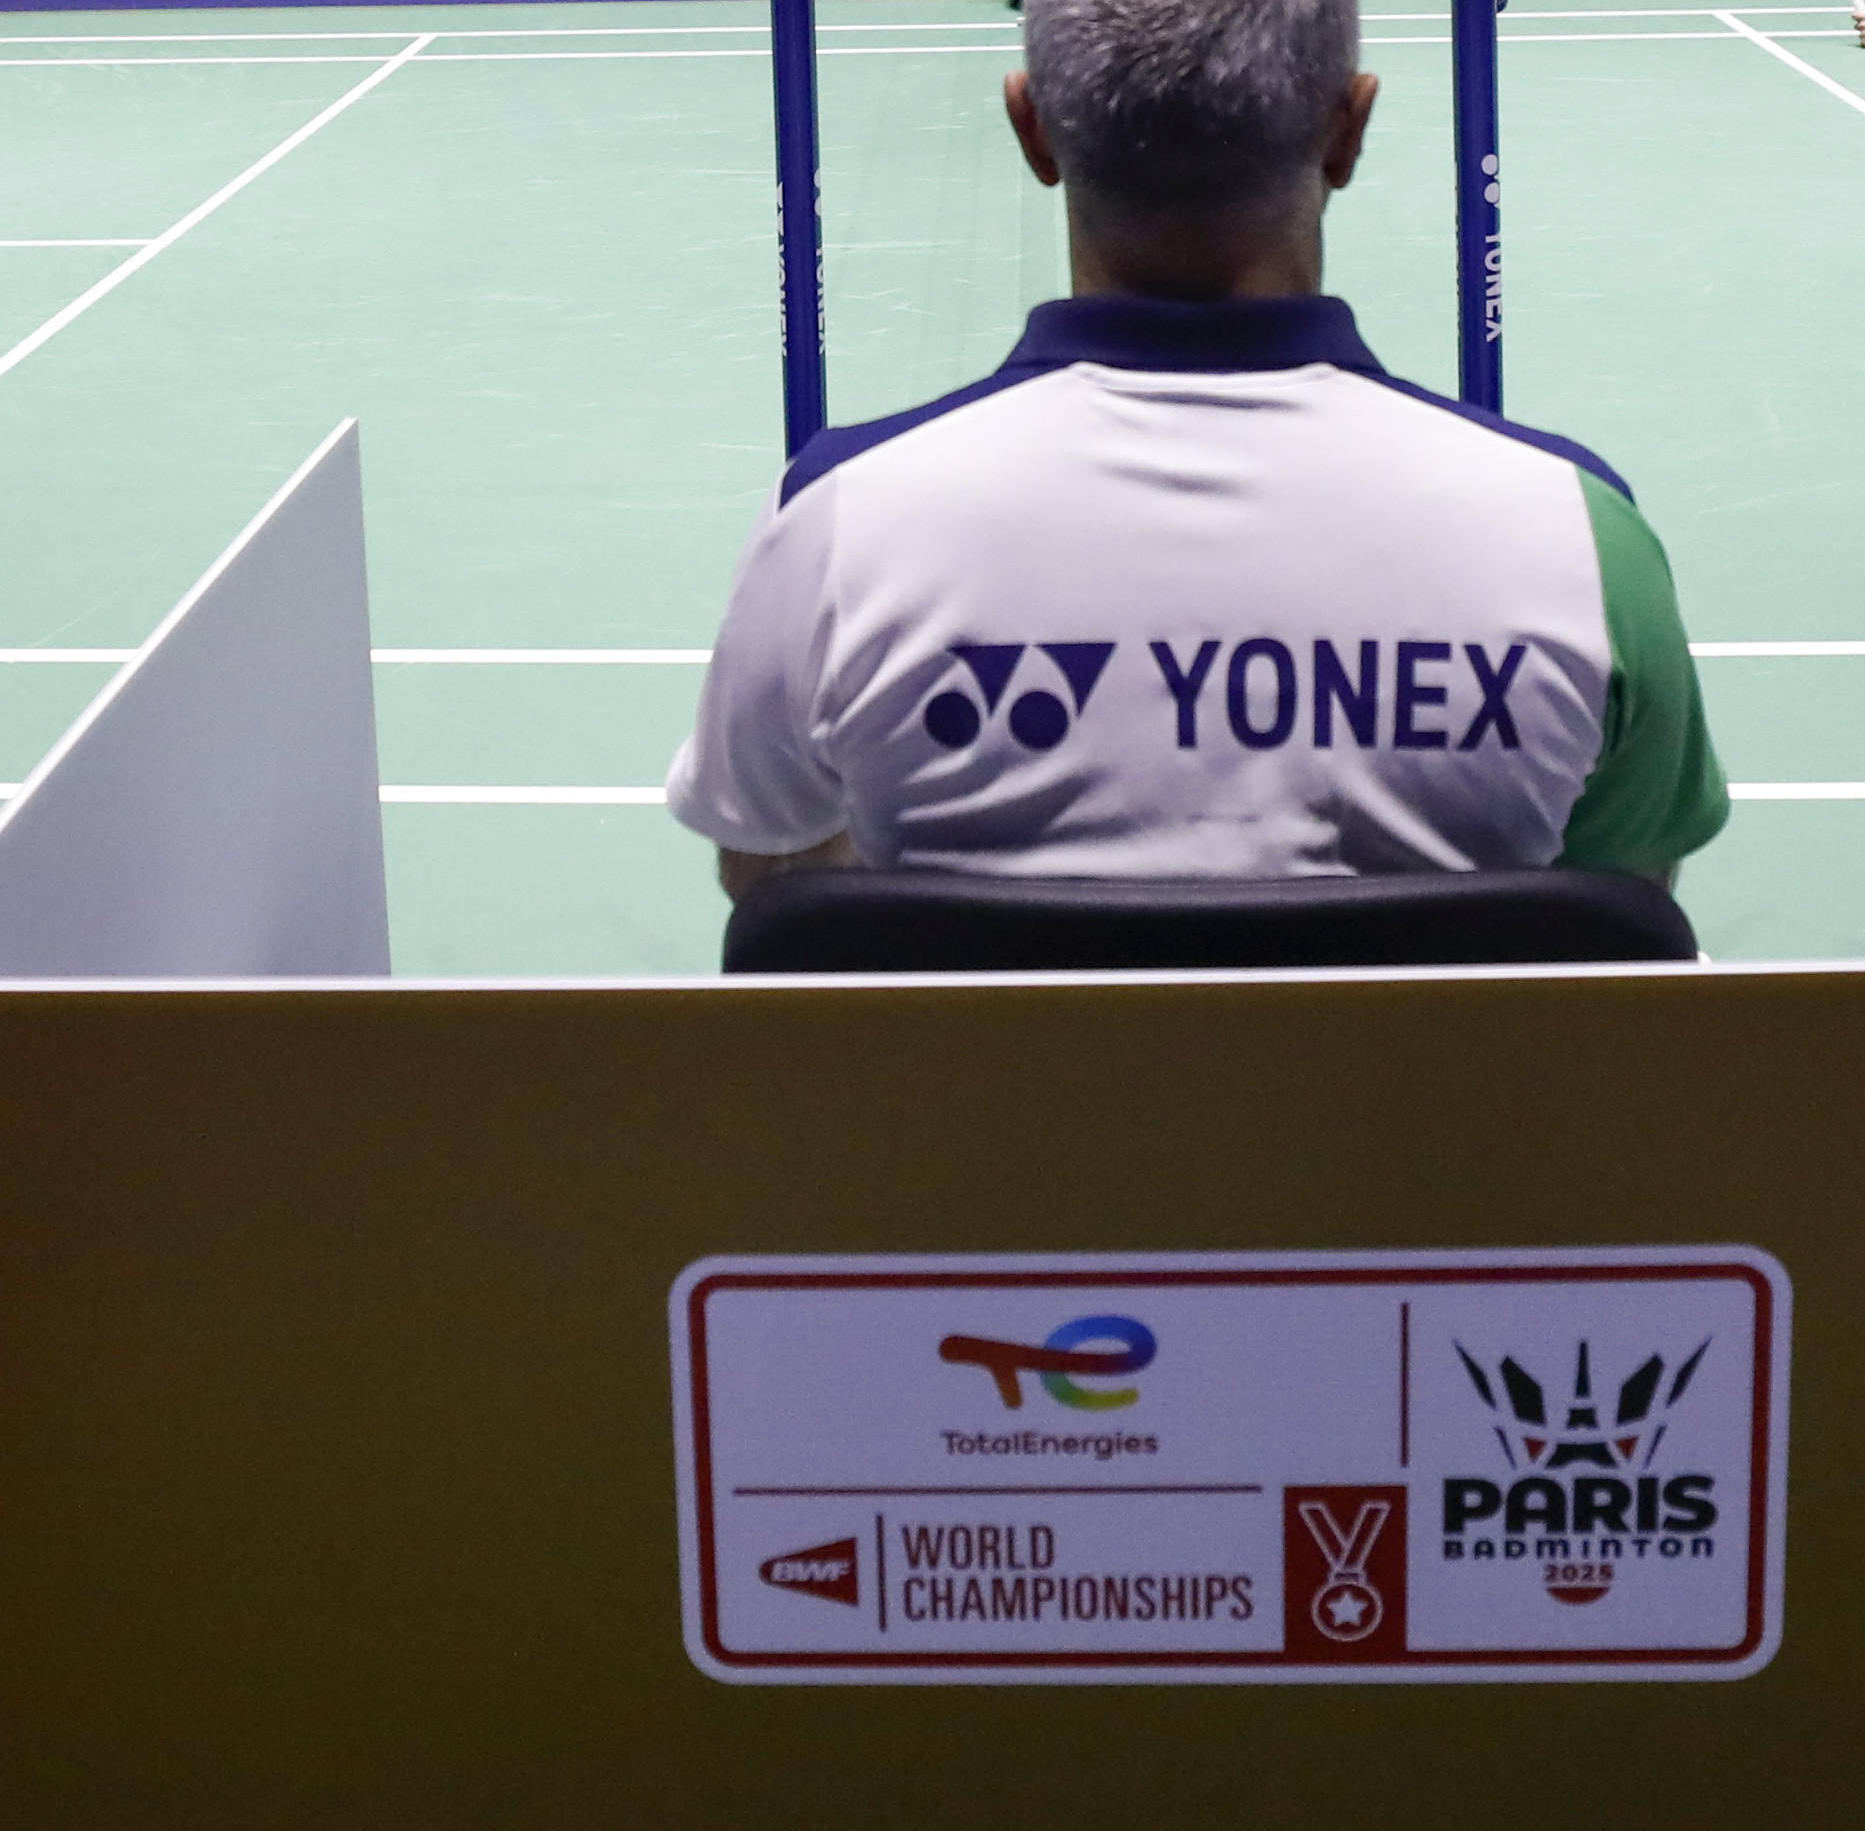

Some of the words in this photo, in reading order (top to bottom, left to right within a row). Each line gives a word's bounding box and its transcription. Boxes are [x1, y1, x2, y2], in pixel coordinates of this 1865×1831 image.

[1149, 638, 1529, 750] YONEX
[940, 1431, 1159, 1460] TotalEnergies
[1443, 1474, 1719, 1535] PARIS
[902, 1524, 1056, 1570] WORLD
[1543, 1563, 1615, 1583] 2025
[902, 1575, 1255, 1622] CHAMPIONSHIPS
